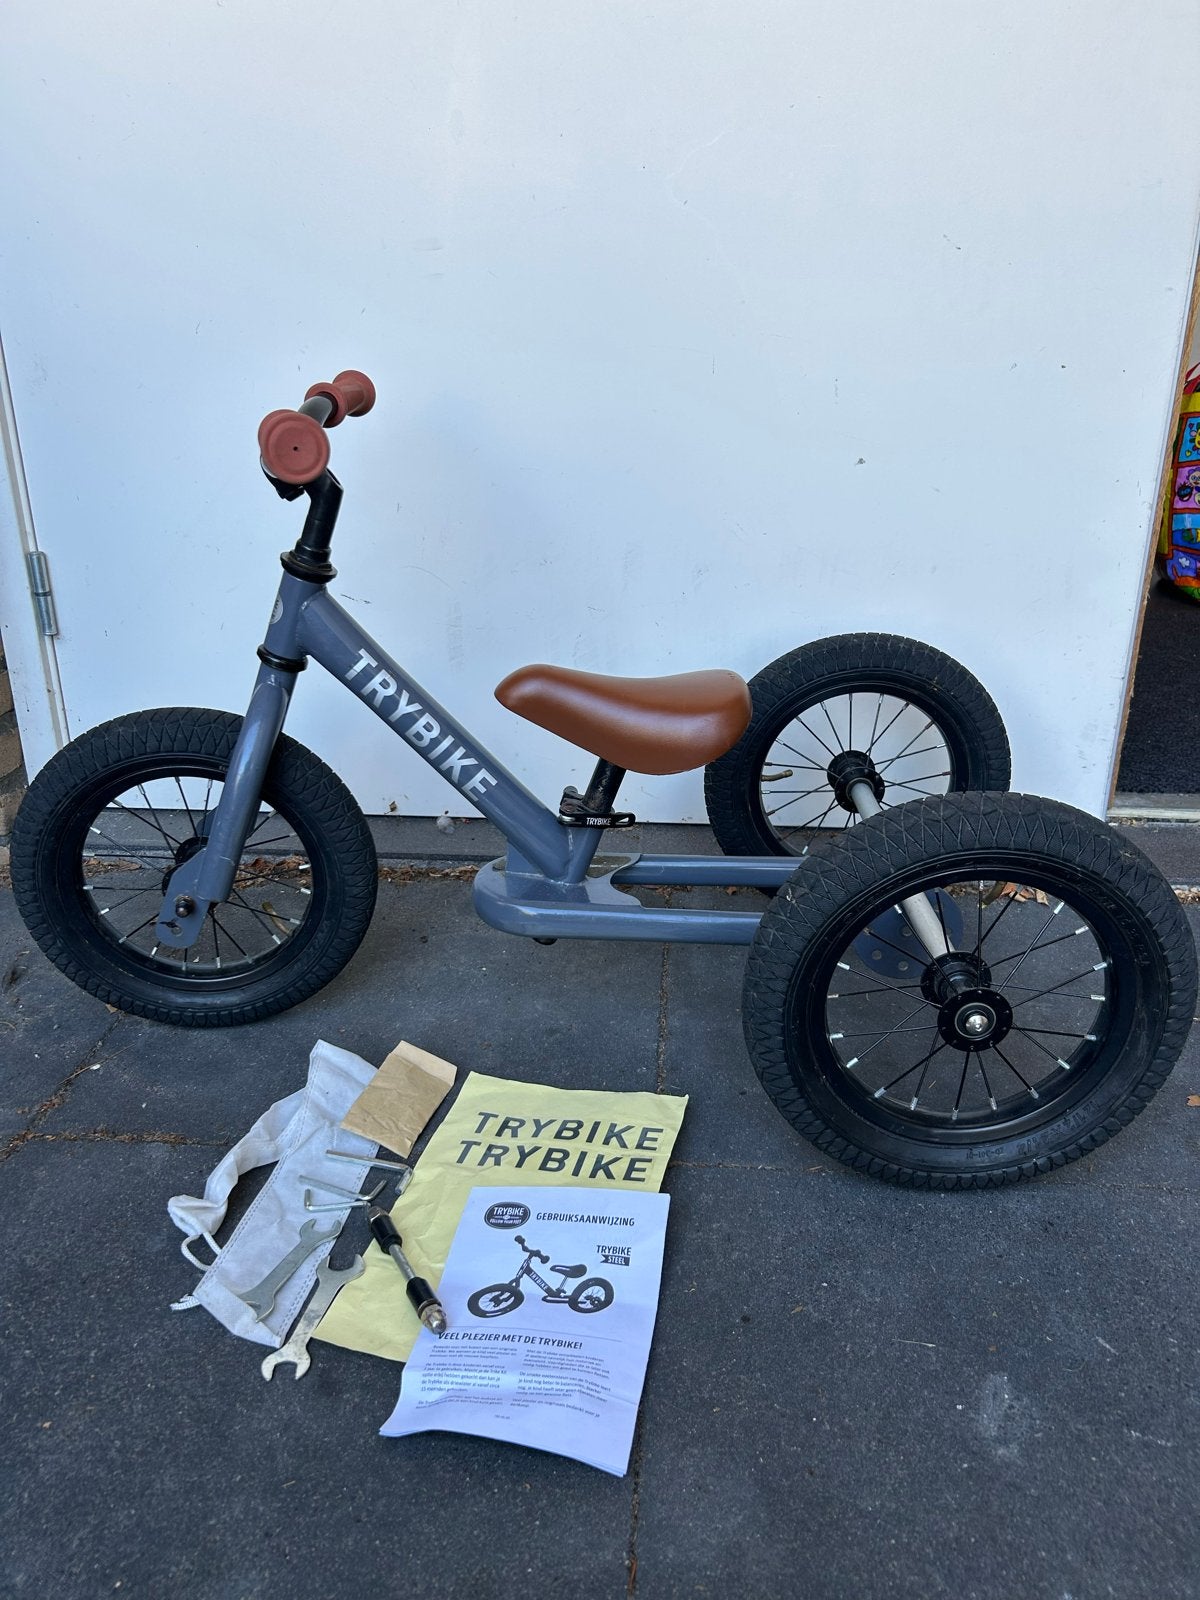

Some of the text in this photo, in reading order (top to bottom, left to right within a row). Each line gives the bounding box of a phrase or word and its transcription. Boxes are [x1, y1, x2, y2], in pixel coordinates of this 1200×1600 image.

[344, 648, 498, 802] TRYBIKE
[586, 817, 612, 826] TRYBIKE
[474, 1111, 664, 1151] TRYBIKE
[456, 1140, 653, 1182] TRYBIKE
[493, 1207, 525, 1216] TRYBIKE
[536, 1212, 635, 1227] GEBRUIKSAANWIJZING
[596, 1244, 632, 1256] TRYBIKE
[607, 1255, 626, 1265] STEEL
[530, 1272, 548, 1290] TRYBIKE
[438, 1332, 583, 1349] VEEL PLEZIER MET DE TRYBIKE!
